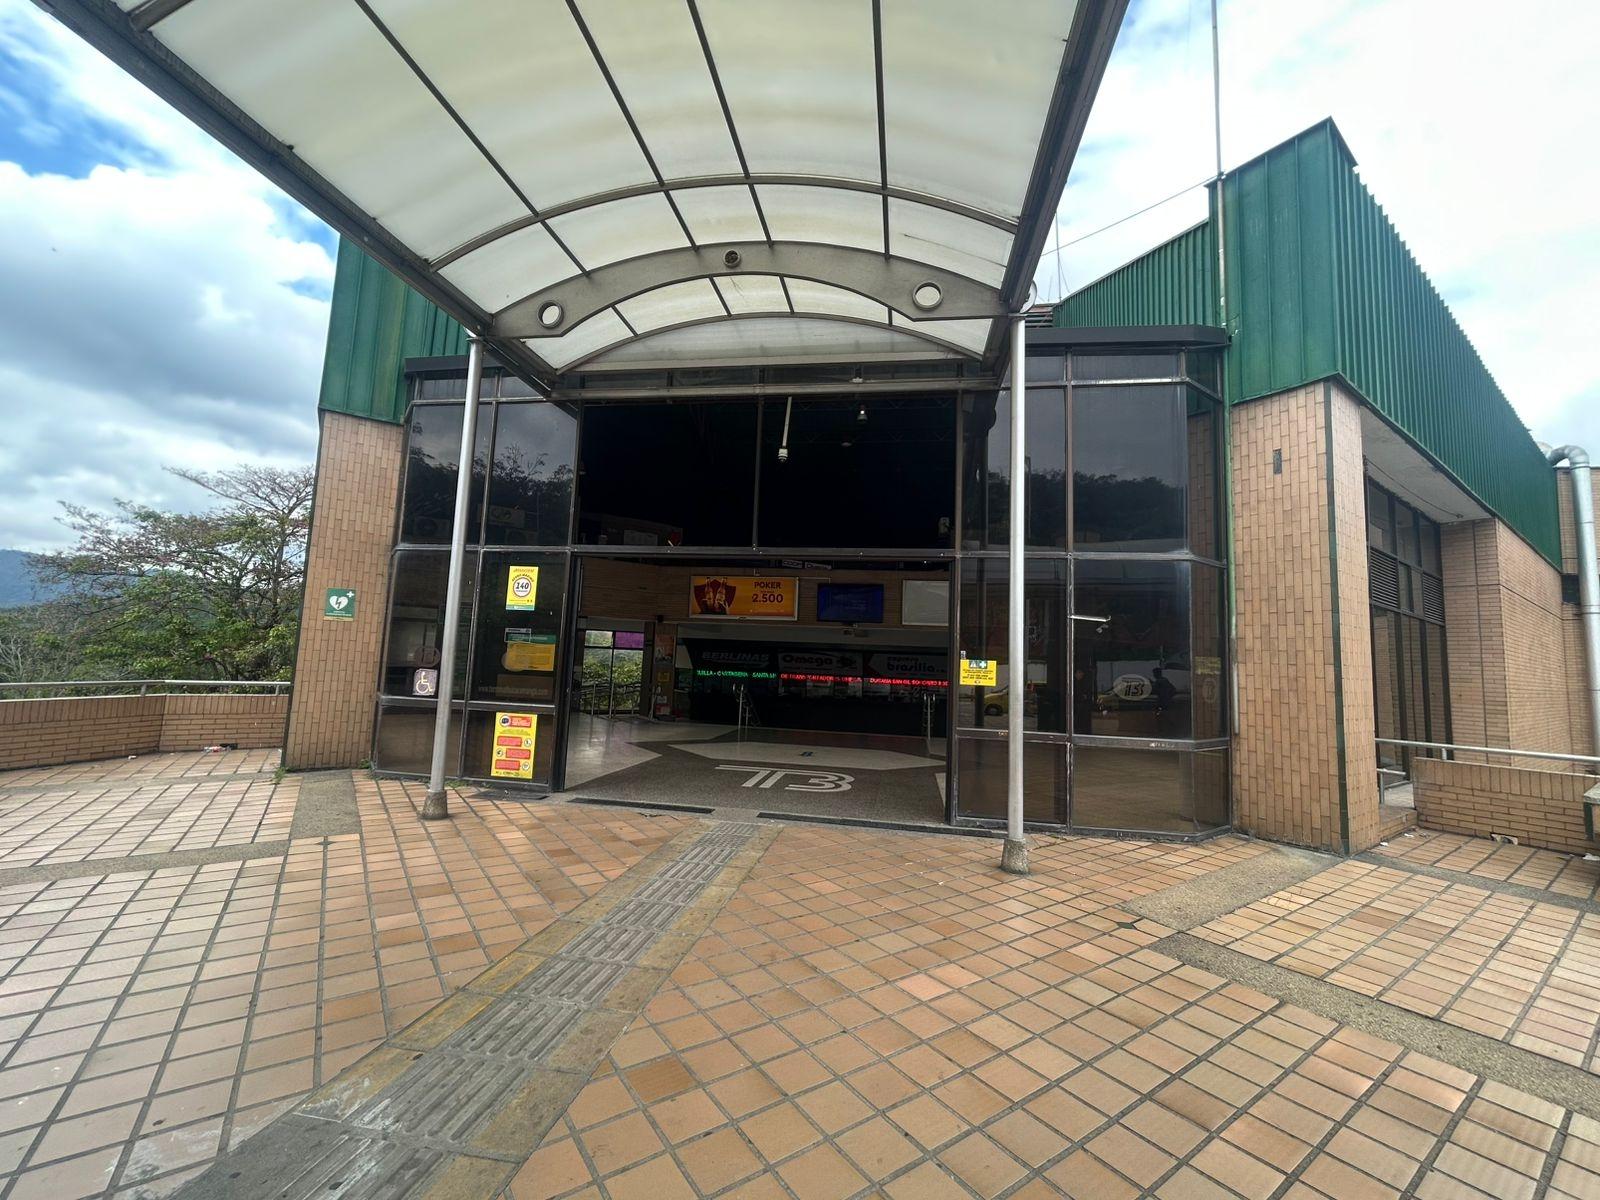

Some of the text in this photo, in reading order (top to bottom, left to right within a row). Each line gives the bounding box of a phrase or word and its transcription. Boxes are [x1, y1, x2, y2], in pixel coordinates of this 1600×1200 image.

[515, 581, 530, 590] 140
[753, 581, 782, 589] POKER
[752, 593, 784, 603] 2.500
[702, 651, 769, 662] BERLINAS
[783, 654, 833, 667] Omega
